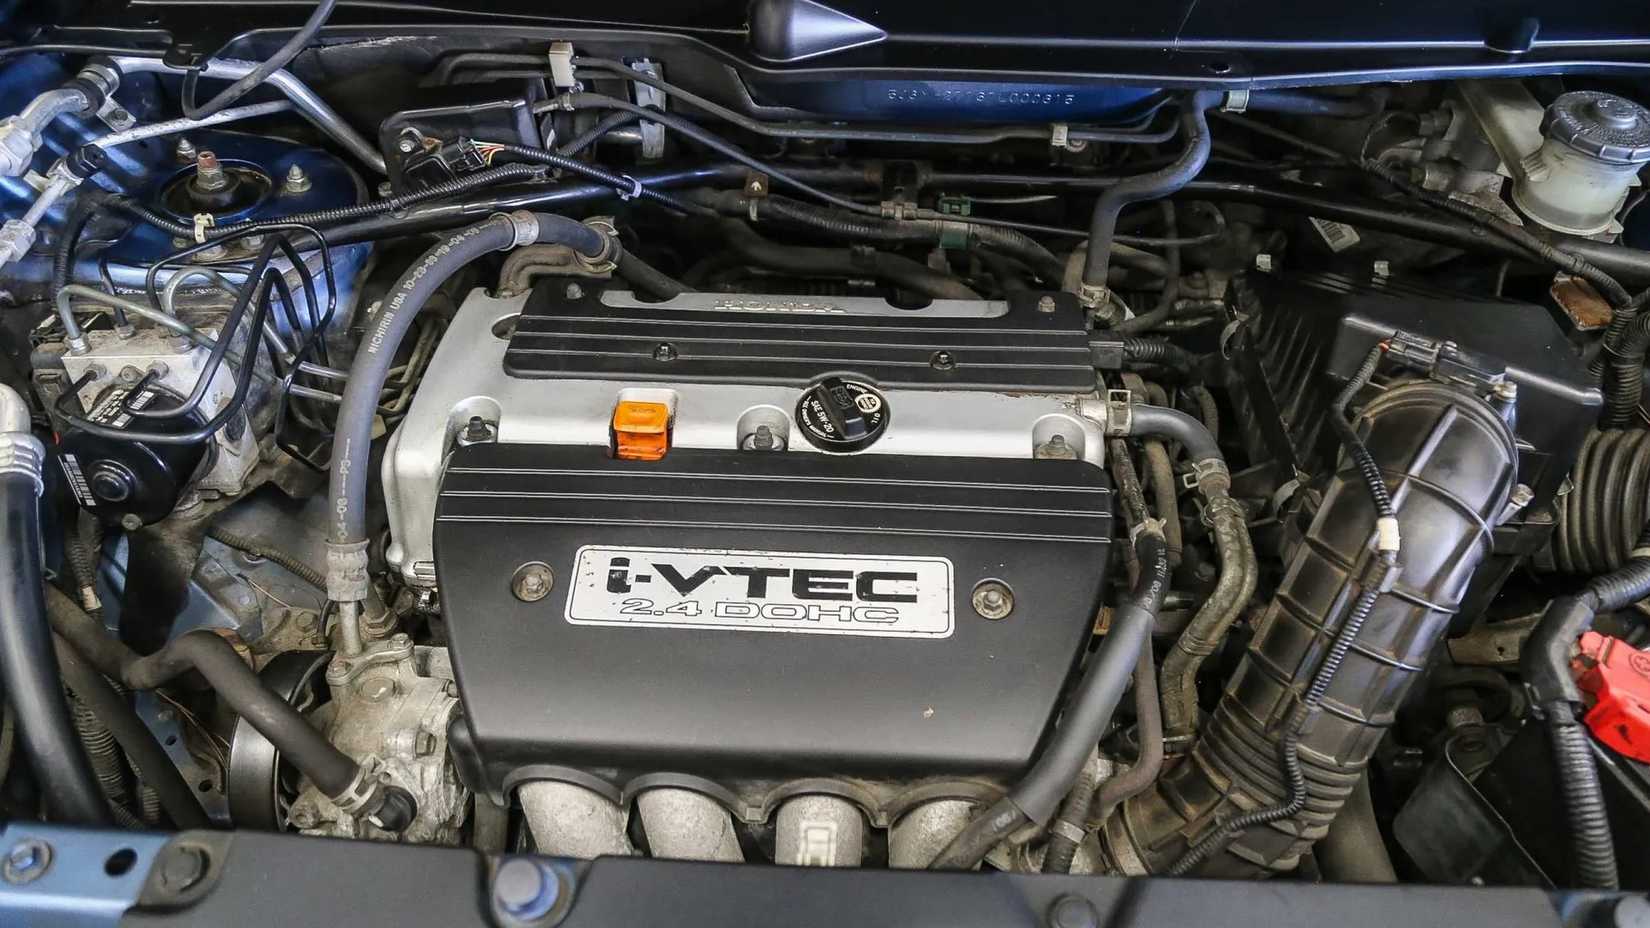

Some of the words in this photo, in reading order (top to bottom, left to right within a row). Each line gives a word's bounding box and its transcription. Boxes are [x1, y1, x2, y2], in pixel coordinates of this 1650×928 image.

[367, 311, 394, 354] NICHIRIN
[605, 556, 918, 603] i-VTEC
[619, 598, 702, 618] 2.4
[714, 601, 900, 624] DOHC
